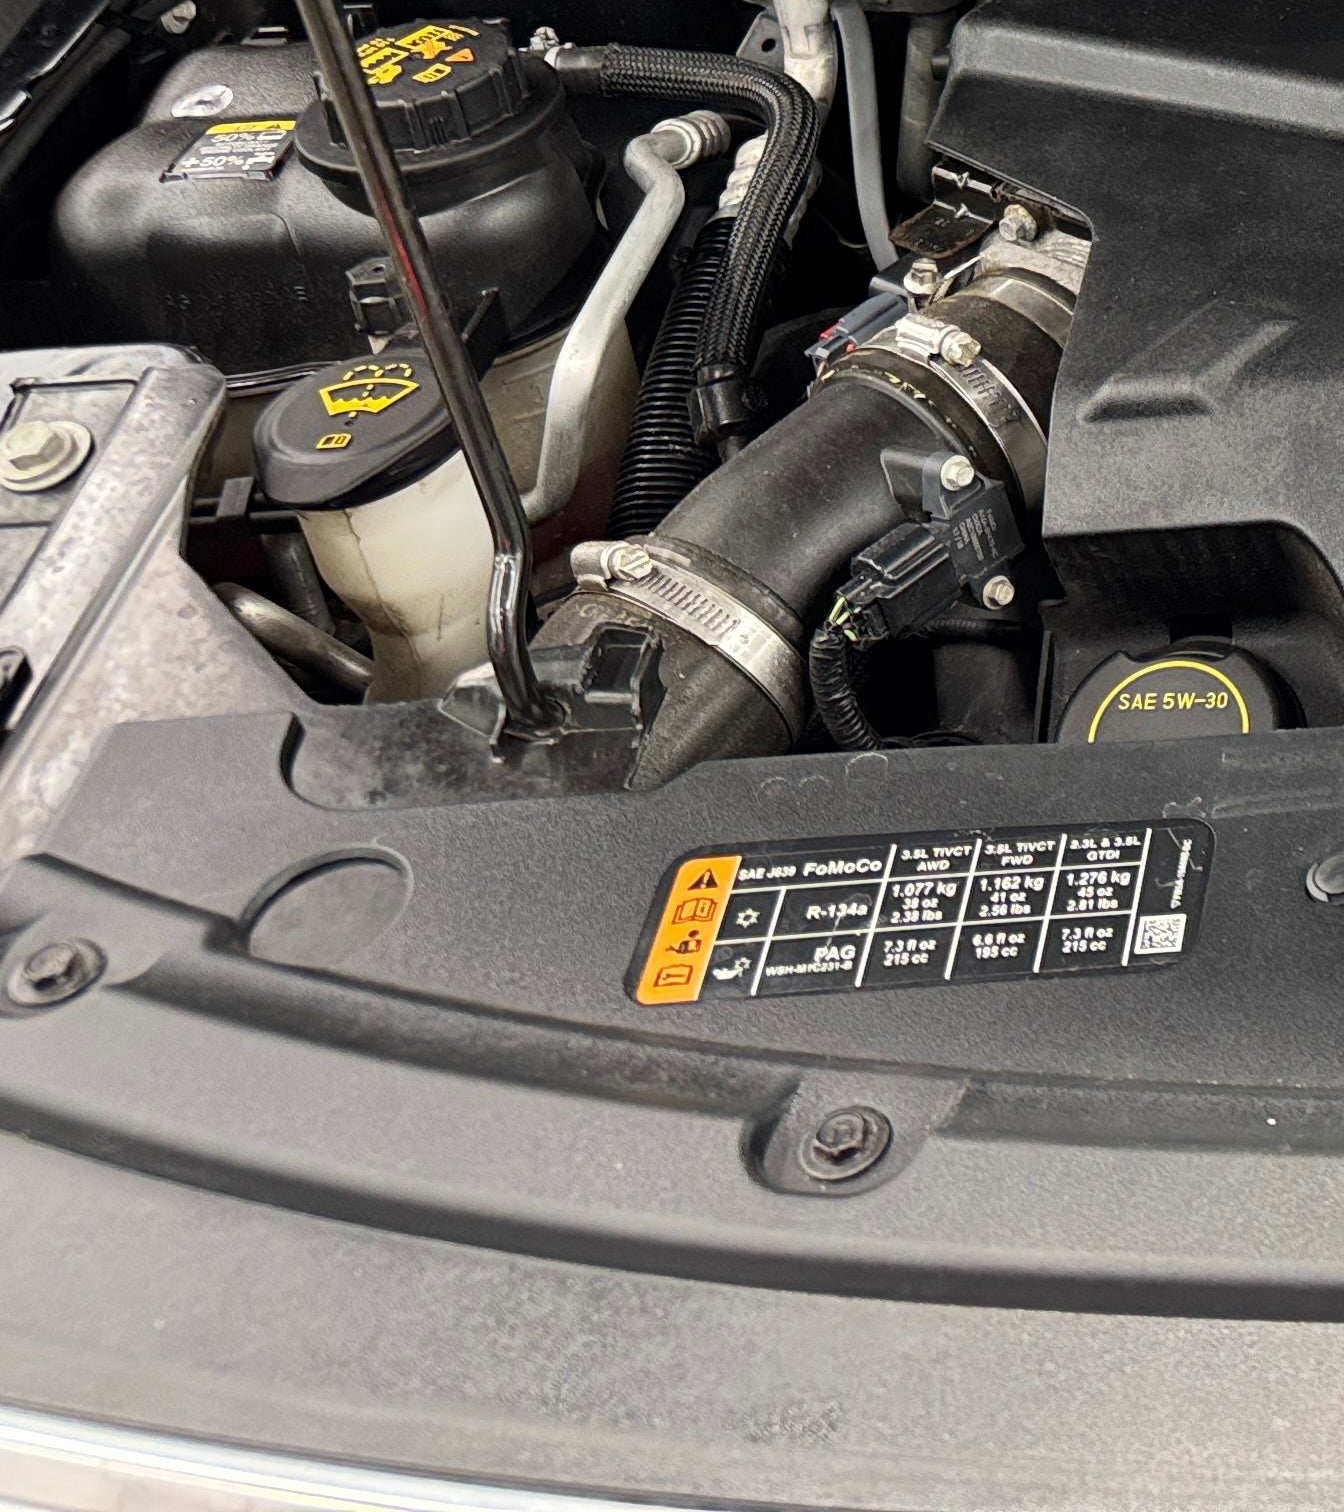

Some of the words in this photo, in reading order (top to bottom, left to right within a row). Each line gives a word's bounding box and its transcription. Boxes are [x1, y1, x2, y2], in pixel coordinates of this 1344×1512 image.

[1117, 692, 1158, 711] SAE
[1162, 691, 1229, 711] 5W-30
[984, 843, 1012, 855] 3.5L
[1069, 839, 1097, 850] 2.3L
[1113, 835, 1141, 847] 3.5L
[901, 848, 929, 861] 3.5L
[1001, 854, 1034, 867] FWD
[738, 867, 765, 881] SAE
[767, 865, 797, 879] J639
[803, 858, 882, 877] FoMoCo
[917, 860, 950, 872] AWD
[980, 876, 1021, 892] 1.162
[1024, 875, 1045, 891] kg
[1066, 871, 1107, 887] 1.276
[1110, 870, 1131, 886] kg
[892, 881, 934, 898] 1.077
[936, 881, 957, 898] kg
[1077, 886, 1094, 898] 45
[1097, 886, 1114, 897] oz
[902, 898, 919, 910] 38
[921, 898, 939, 909] oz
[990, 892, 1006, 903] 41
[1009, 892, 1027, 903] oz
[806, 902, 868, 920] R-134a
[1010, 903, 1031, 915] lbs
[1066, 899, 1094, 912] 2.81
[1098, 899, 1118, 910] lbs
[890, 910, 919, 924] 2.38
[921, 910, 943, 921] lbs
[1008, 933, 1026, 944] oz
[1062, 928, 1082, 941] 7.3
[1096, 927, 1114, 938] oz
[814, 944, 856, 962] PAG
[883, 940, 904, 953] 7.3
[919, 939, 937, 950] oz
[976, 946, 999, 959] 195
[1001, 946, 1018, 957] cc
[1062, 941, 1087, 953] 215
[1089, 940, 1107, 951] cc
[883, 953, 909, 967] 215
[911, 953, 929, 964] cc
